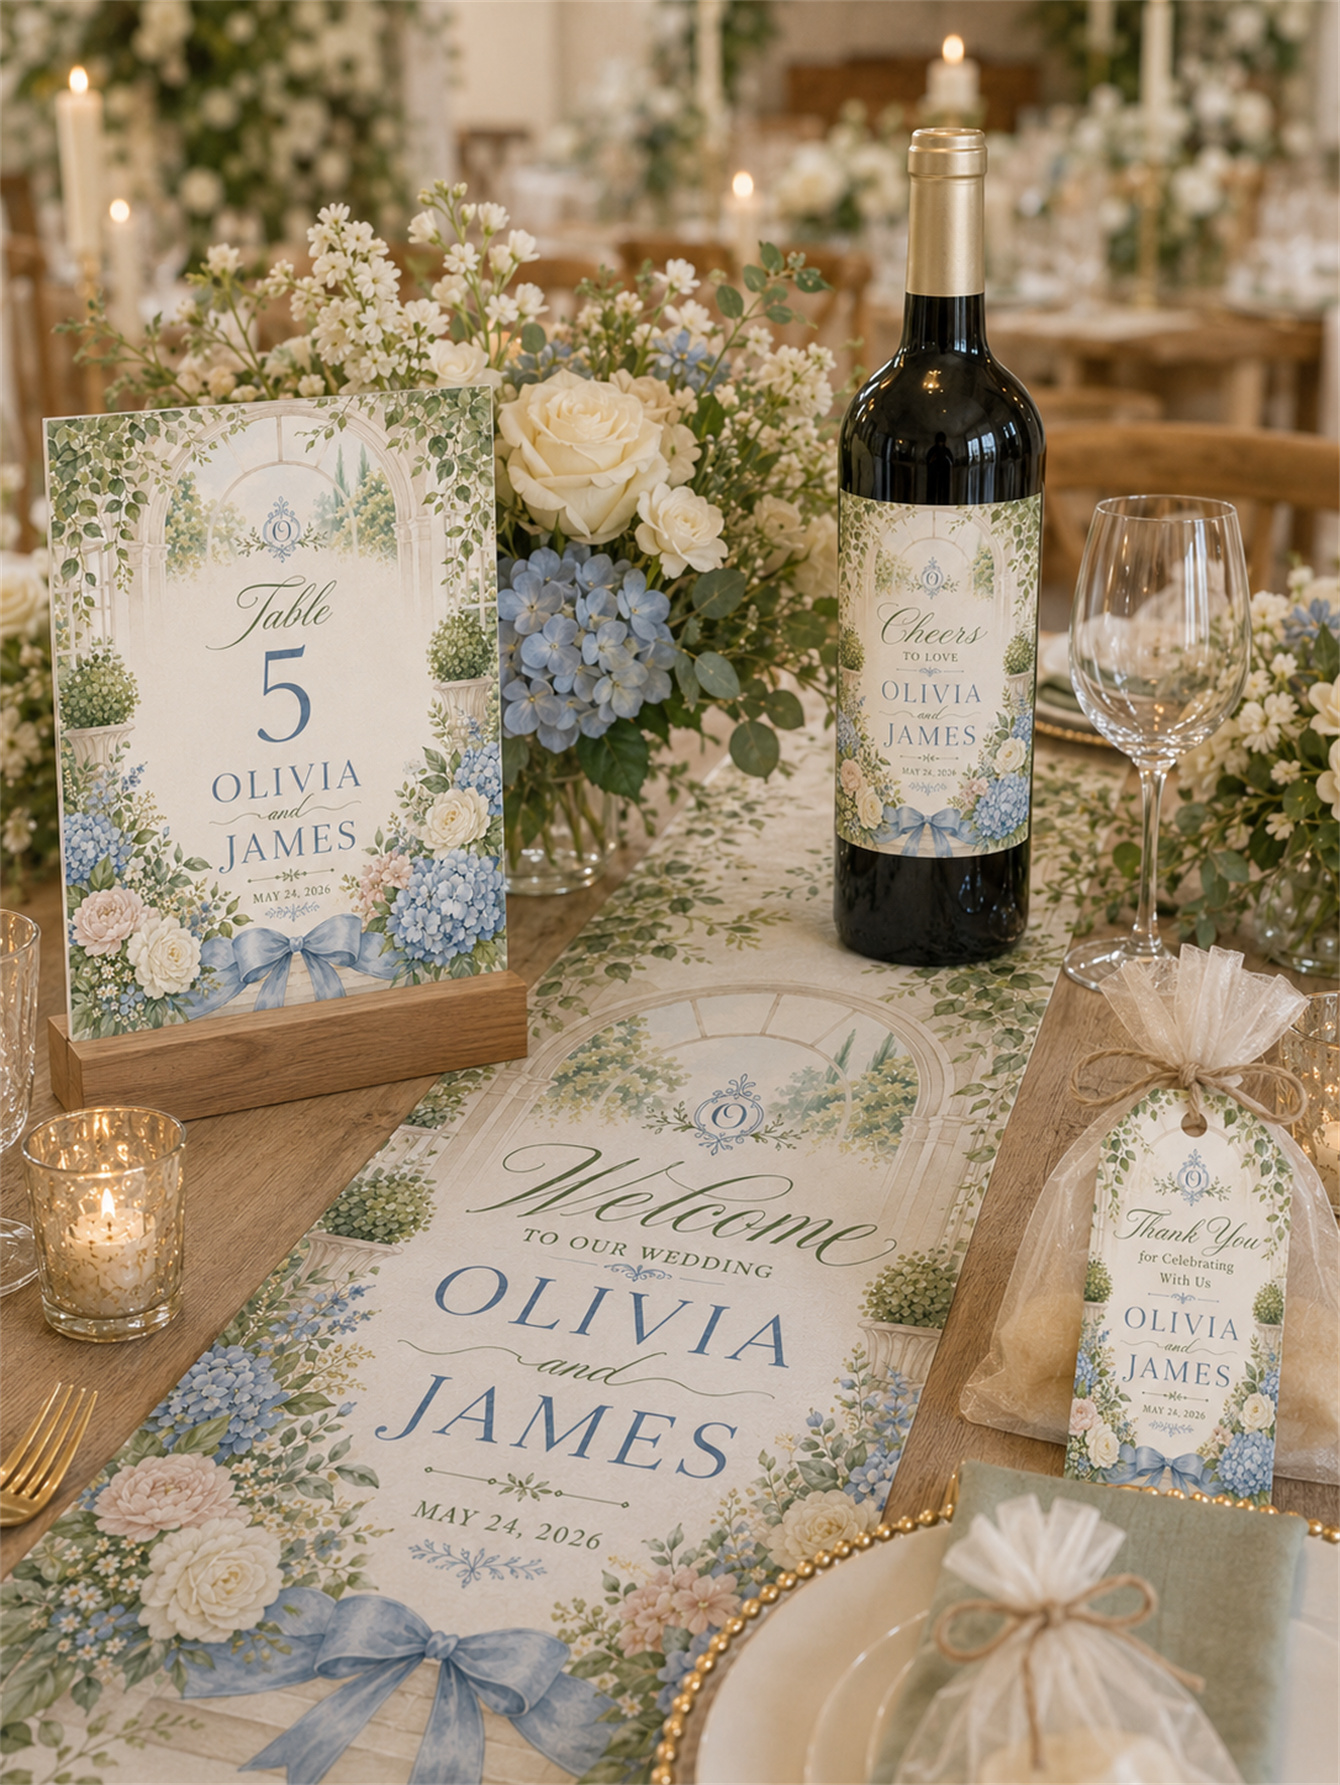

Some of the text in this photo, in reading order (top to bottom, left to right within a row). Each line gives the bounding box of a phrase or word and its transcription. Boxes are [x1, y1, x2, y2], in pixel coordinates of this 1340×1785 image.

[205, 575, 338, 651] Table
[876, 601, 989, 646] Cheers
[902, 651, 959, 663] TO LOVE
[257, 644, 312, 744] 5
[881, 680, 982, 704] OLIVIA
[883, 722, 977, 748] JAMES
[212, 759, 361, 803] OLIVIA
[902, 767, 920, 776] MAY
[218, 820, 356, 874] JAMES
[253, 890, 280, 904] MAY
[304, 884, 332, 897] 2026
[465, 1143, 898, 1267] Welcome
[522, 1227, 775, 1280] TO OUR WEDDING
[1112, 1208, 1262, 1258] Thank You
[1138, 1250, 1235, 1275] for Celebrating
[1159, 1272, 1212, 1289] With Us
[434, 1265, 790, 1369] OLIVIA
[1124, 1306, 1239, 1341] OLIVIA
[1122, 1354, 1230, 1388] JAMES
[375, 1373, 739, 1480] JAMES
[1142, 1404, 1165, 1415] MAY
[1183, 1409, 1206, 1421] 2026
[411, 1500, 604, 1550] MAY 24, 2026
